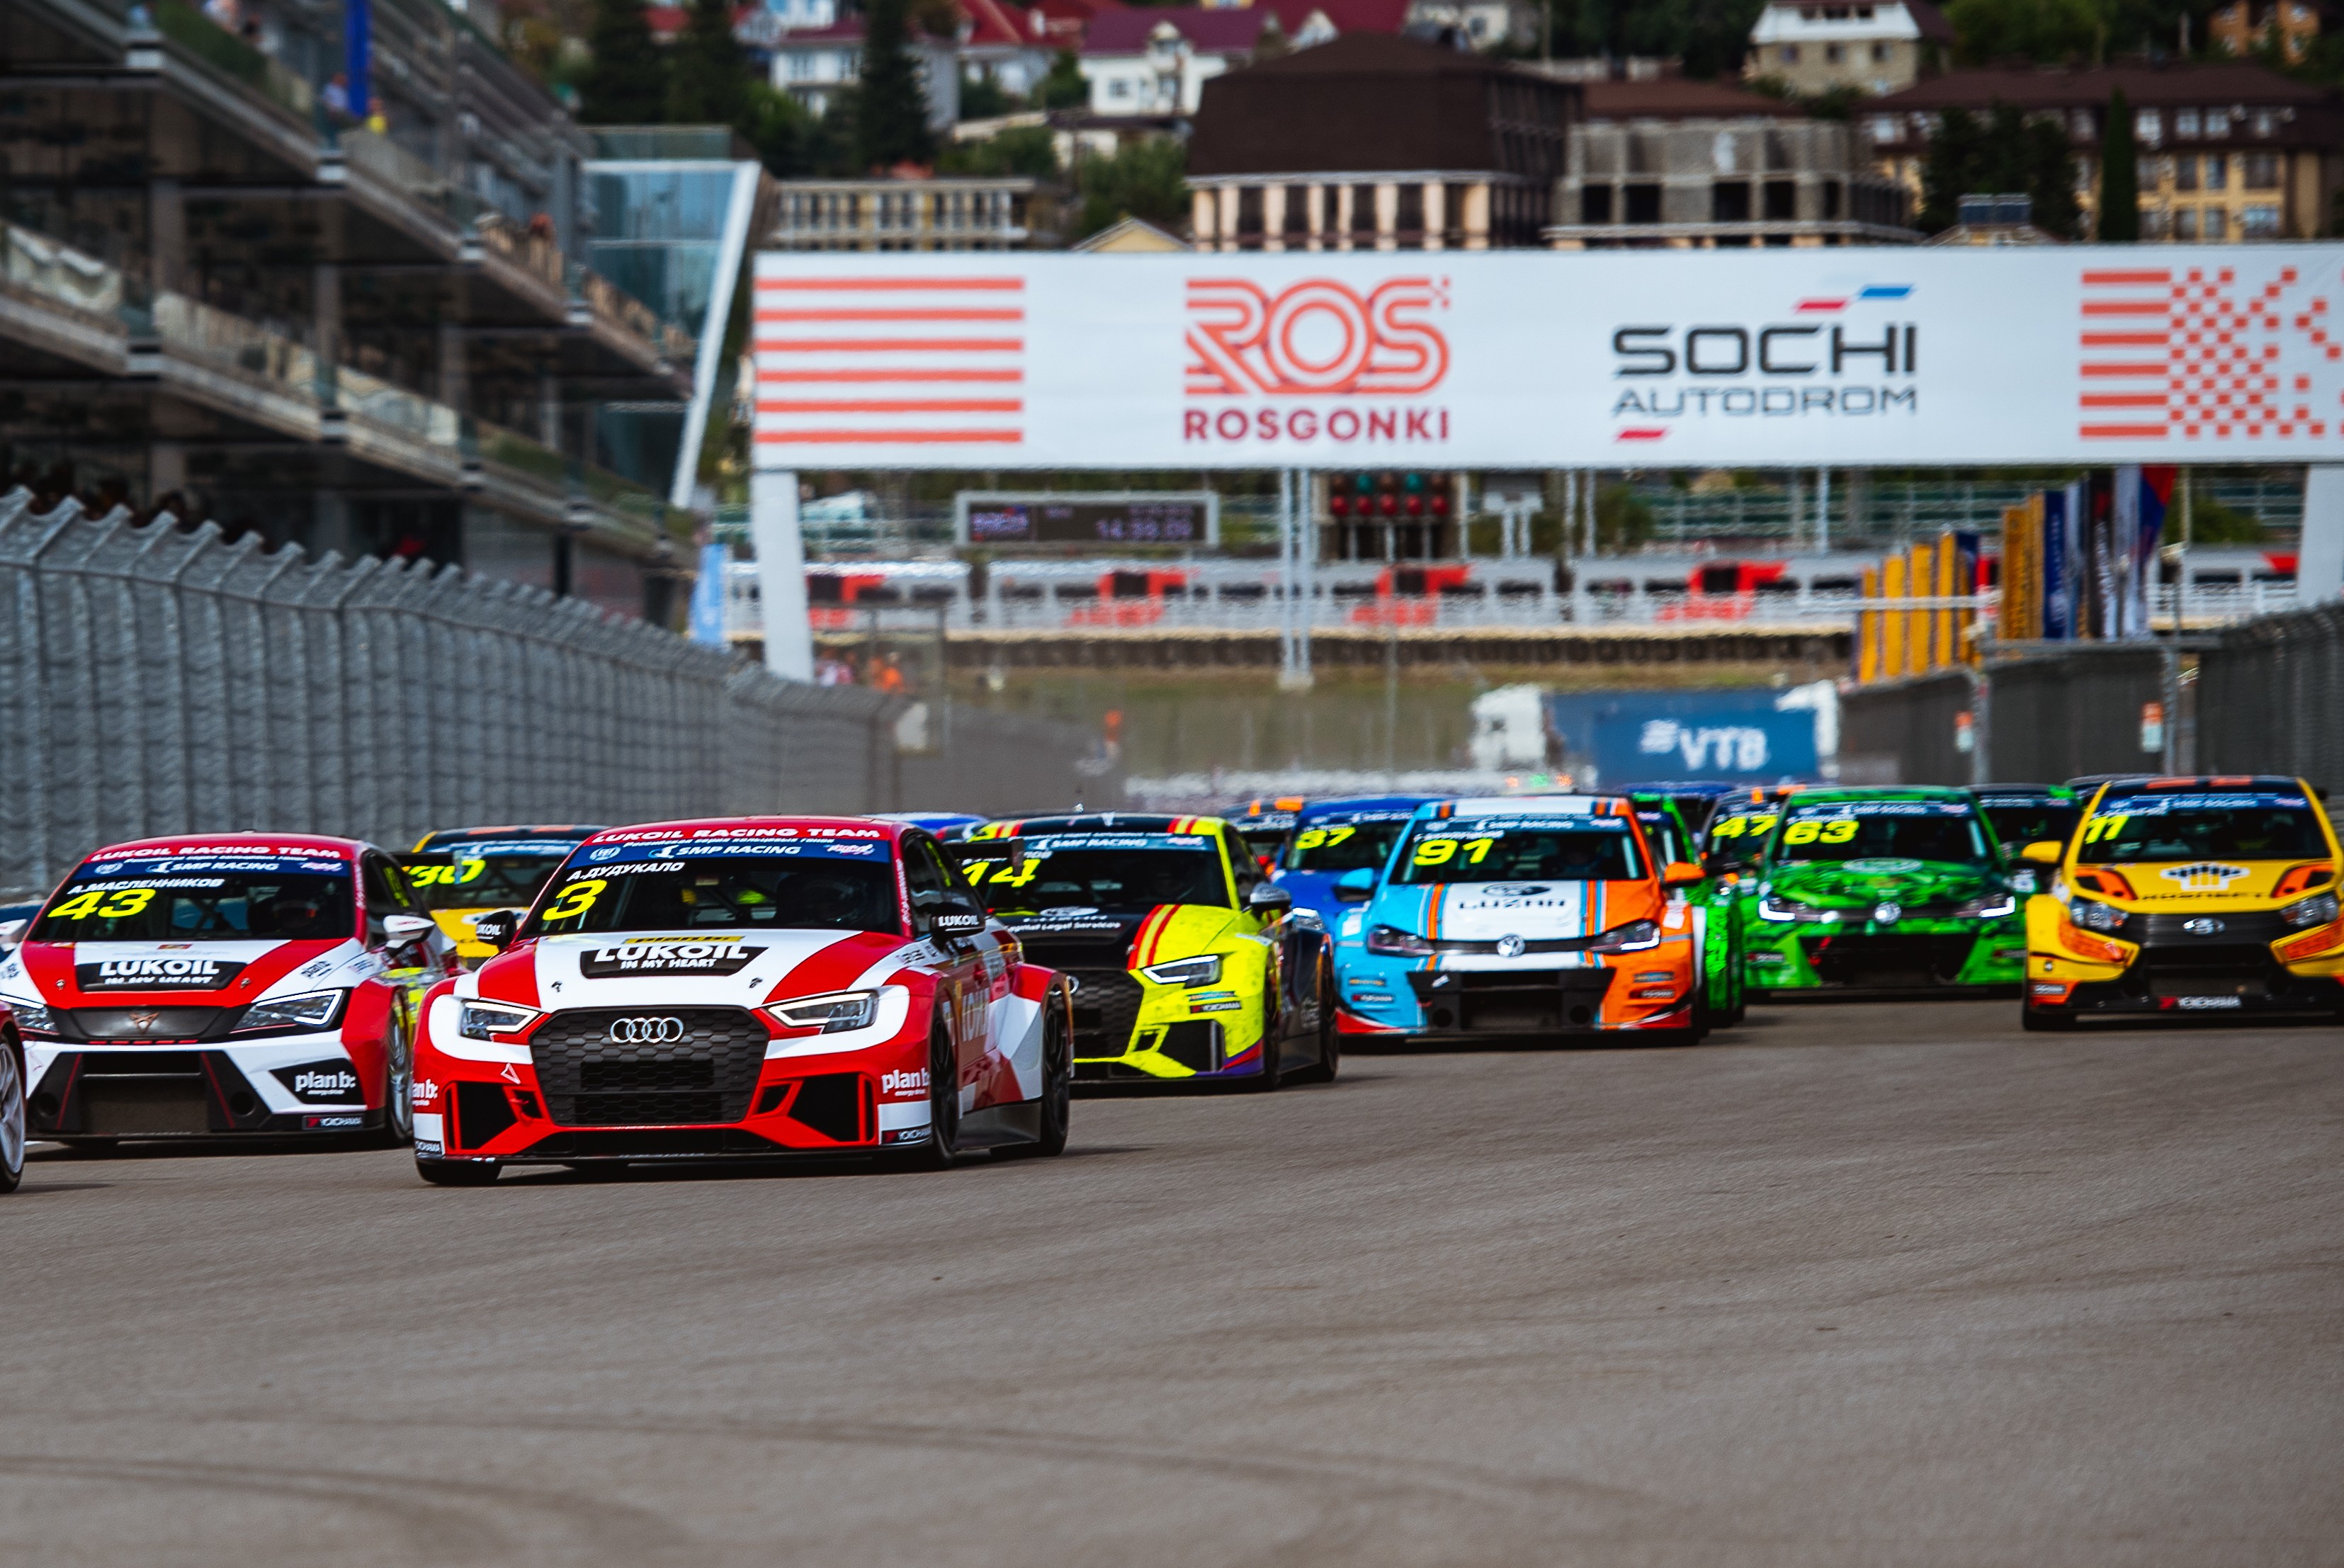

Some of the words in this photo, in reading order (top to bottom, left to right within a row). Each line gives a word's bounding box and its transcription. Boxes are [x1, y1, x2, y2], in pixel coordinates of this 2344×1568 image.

[1184, 277, 1449, 394] ROS
[1612, 322, 1918, 377] SOCHI
[1613, 386, 1917, 416] AUTODROM
[1184, 409, 1449, 441] ROSGONKI
[1681, 726, 1767, 771] VTB
[591, 829, 684, 843] LUKOIL
[692, 828, 798, 838] RACING
[807, 829, 881, 838] TEAM
[1711, 814, 1777, 838] 47
[1783, 820, 1859, 844] 63
[2085, 815, 2129, 844] 11
[91, 847, 171, 862] LUKOIL
[179, 846, 271, 855] RACING
[278, 846, 341, 858] TEAM
[676, 846, 723, 856] SMP
[723, 846, 802, 854] RACING
[1087, 839, 1148, 847] RACING
[1413, 838, 1494, 865] 91
[171, 862, 212, 871] SMP
[212, 861, 280, 870] RACING
[409, 859, 486, 888] 30
[566, 862, 686, 882] А.ДУДУКАЛО
[962, 855, 1041, 887] 14
[47, 889, 157, 920] 43
[543, 879, 607, 920] 3
[939, 914, 979, 927] LUKOIL
[594, 945, 749, 962] LUKOIL
[620, 960, 638, 970] IN
[641, 959, 666, 969] MY
[668, 958, 717, 968] HEART
[99, 960, 220, 977] LUKOIL
[295, 1071, 337, 1092] plan
[339, 1070, 356, 1089] b:
[412, 1082, 424, 1098] an
[881, 1069, 922, 1094] plan
